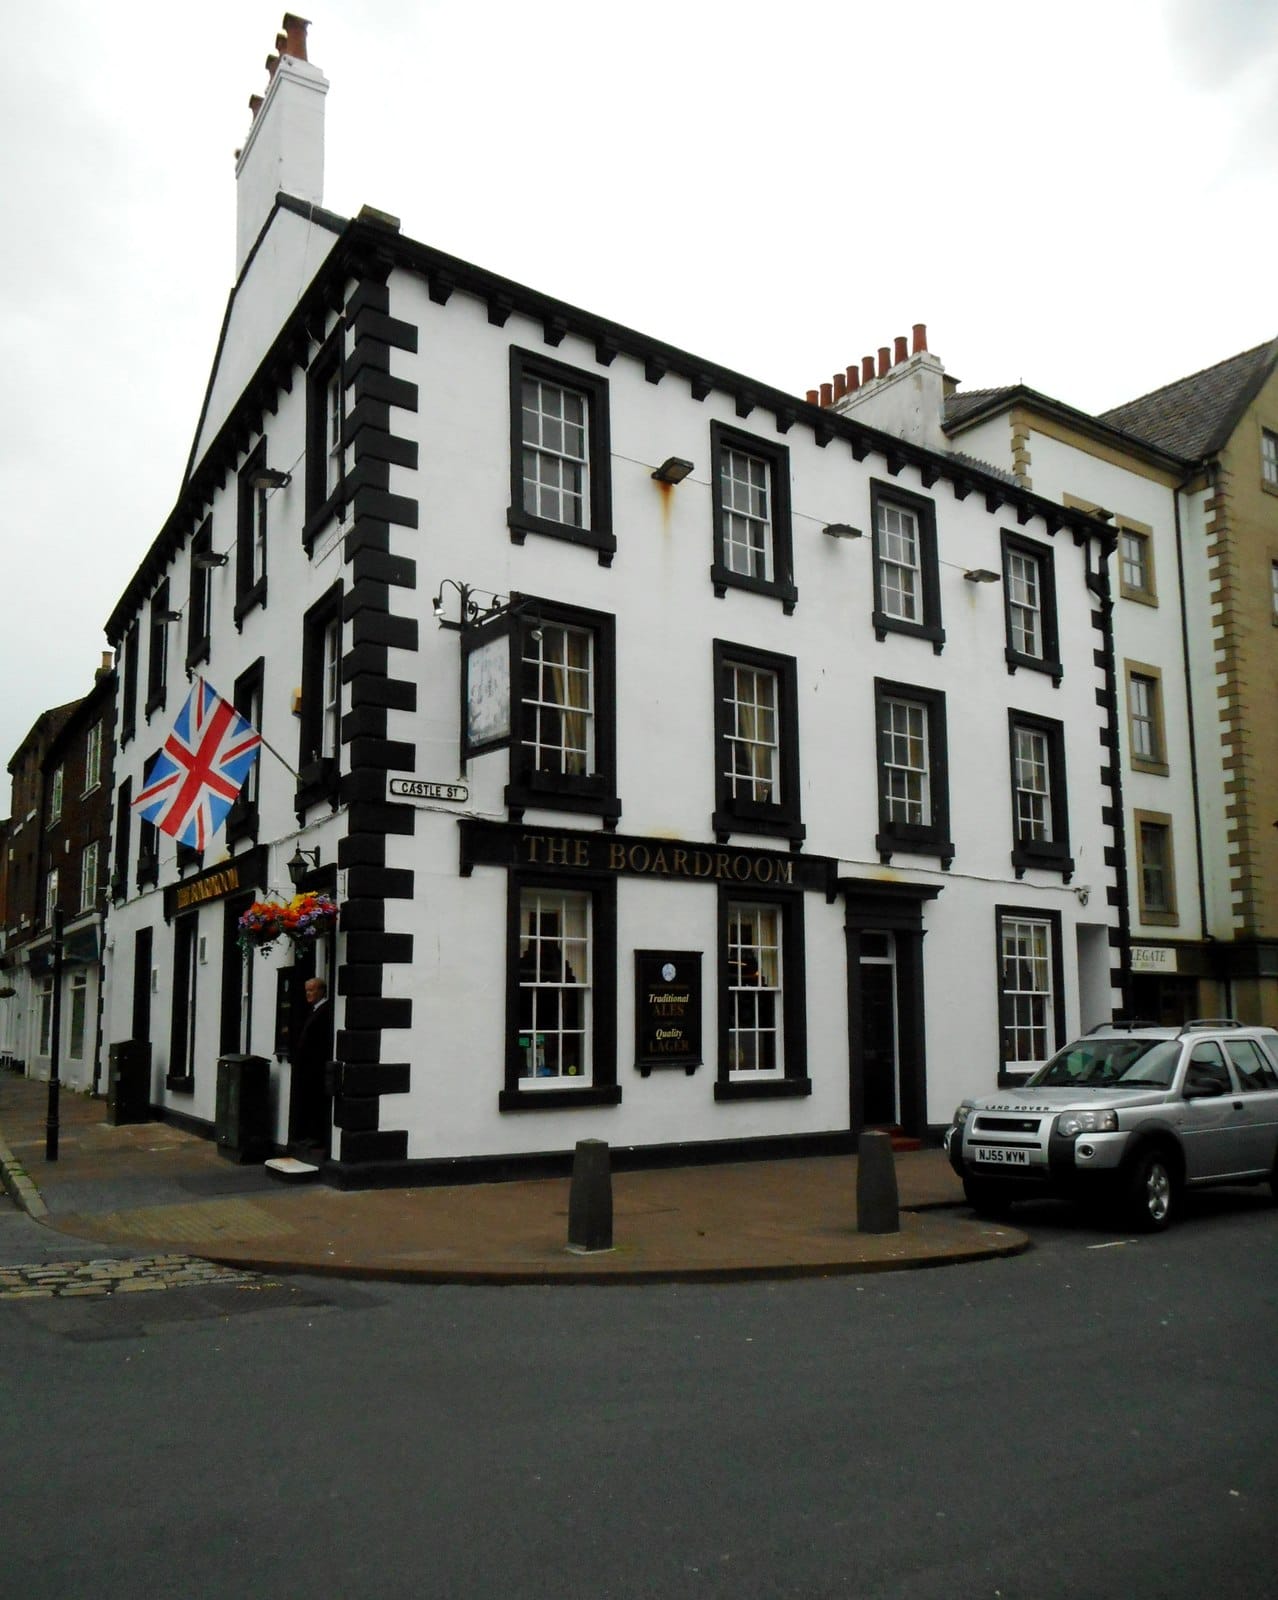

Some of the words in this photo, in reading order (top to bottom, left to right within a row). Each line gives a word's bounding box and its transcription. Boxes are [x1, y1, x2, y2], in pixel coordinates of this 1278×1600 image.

[401, 782, 441, 797] CASTLE
[446, 787, 458, 798] ST
[523, 833, 592, 867] THE
[609, 842, 795, 884] BOARDROOM
[648, 993, 690, 1004] Traditional
[654, 1004, 685, 1017] ALES
[655, 1028, 683, 1040] Quality
[648, 1040, 689, 1053] LAGER
